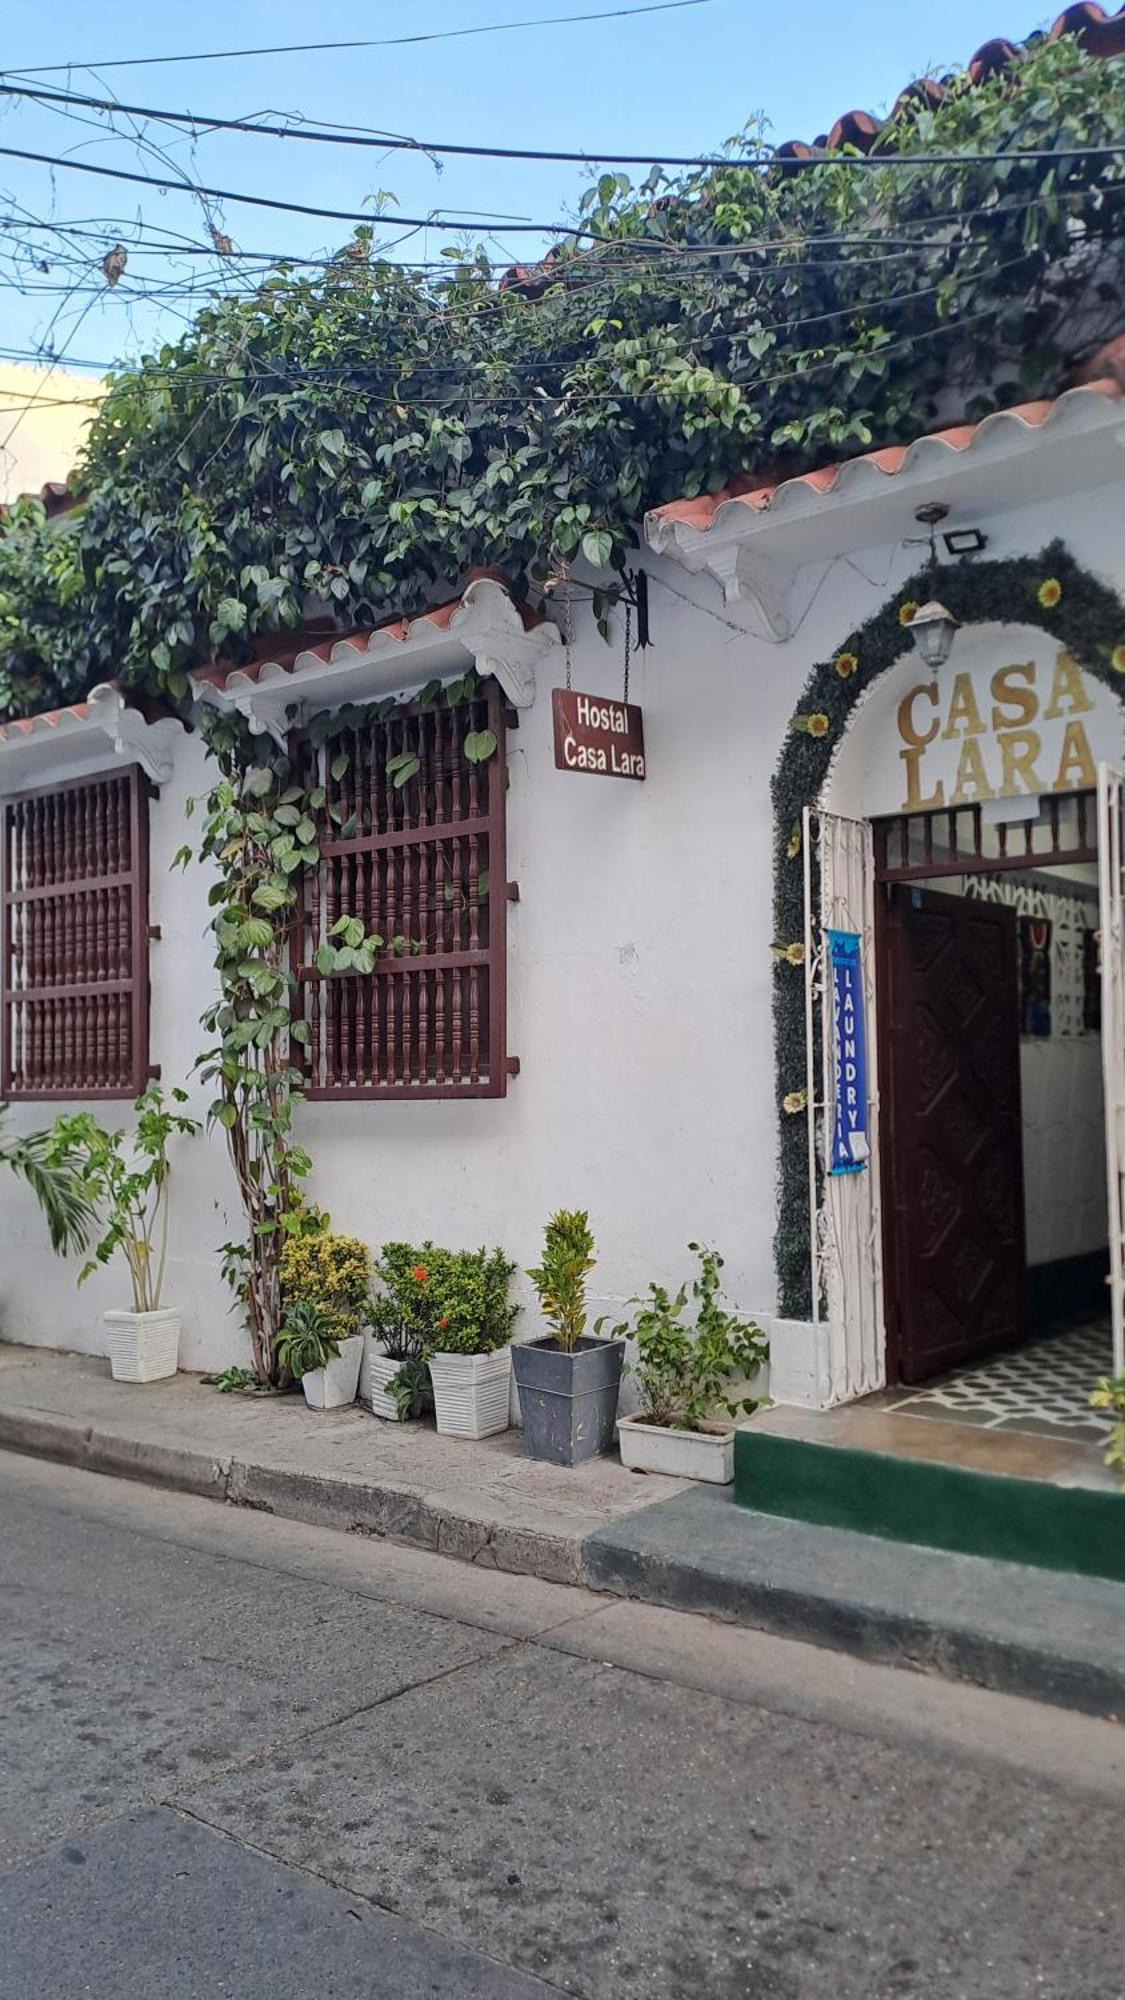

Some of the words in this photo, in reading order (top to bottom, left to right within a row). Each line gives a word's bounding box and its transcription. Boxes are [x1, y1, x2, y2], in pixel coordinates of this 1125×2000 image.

[577, 697, 629, 734] Hostal
[897, 649, 1096, 747] CASA
[564, 735, 607, 770] Casa
[611, 744, 645, 777] Lara
[899, 720, 1098, 810] LARA
[844, 968, 858, 1129] LAUNDRY
